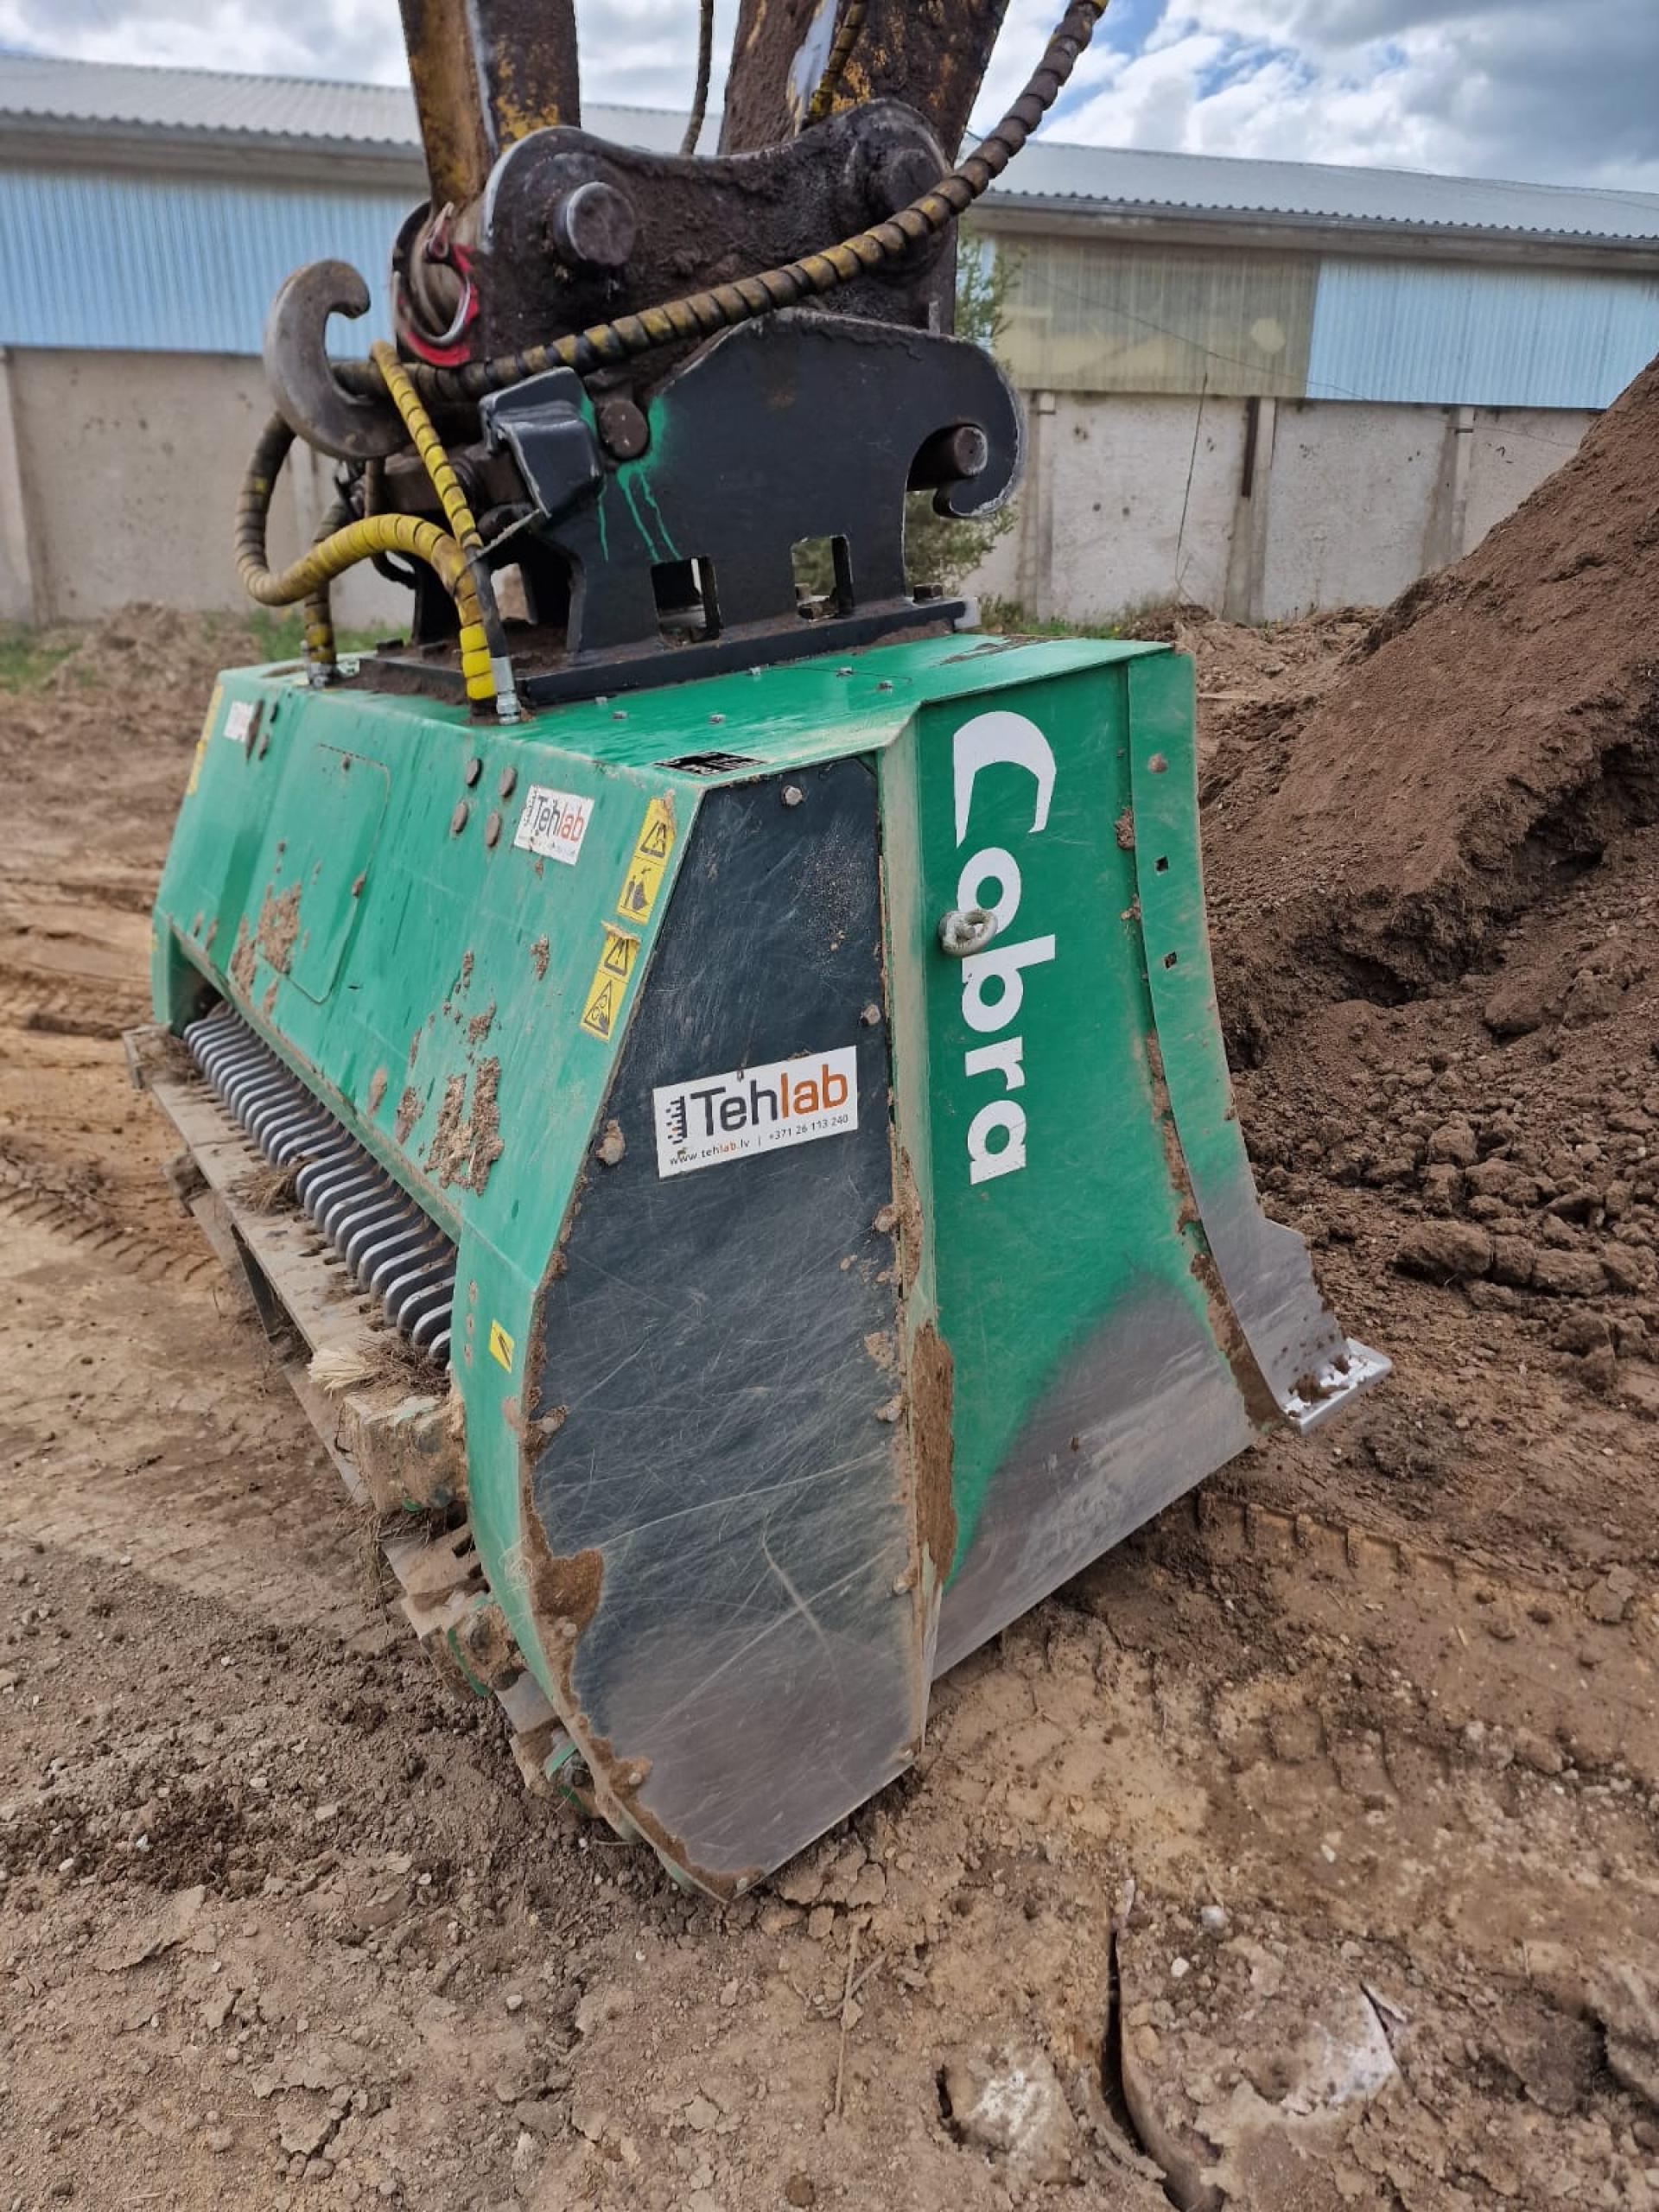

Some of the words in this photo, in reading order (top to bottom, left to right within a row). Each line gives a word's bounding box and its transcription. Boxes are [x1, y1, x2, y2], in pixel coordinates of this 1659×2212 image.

[534, 795, 584, 842] Tehlab
[952, 709, 1057, 1185] Cobra
[690, 1064, 849, 1136] Tehlab
[670, 1138, 750, 1166] www.tehlab.lv
[796, 1123, 808, 1135] 26
[812, 1120, 828, 1131] 113
[830, 1113, 849, 1127] 240
